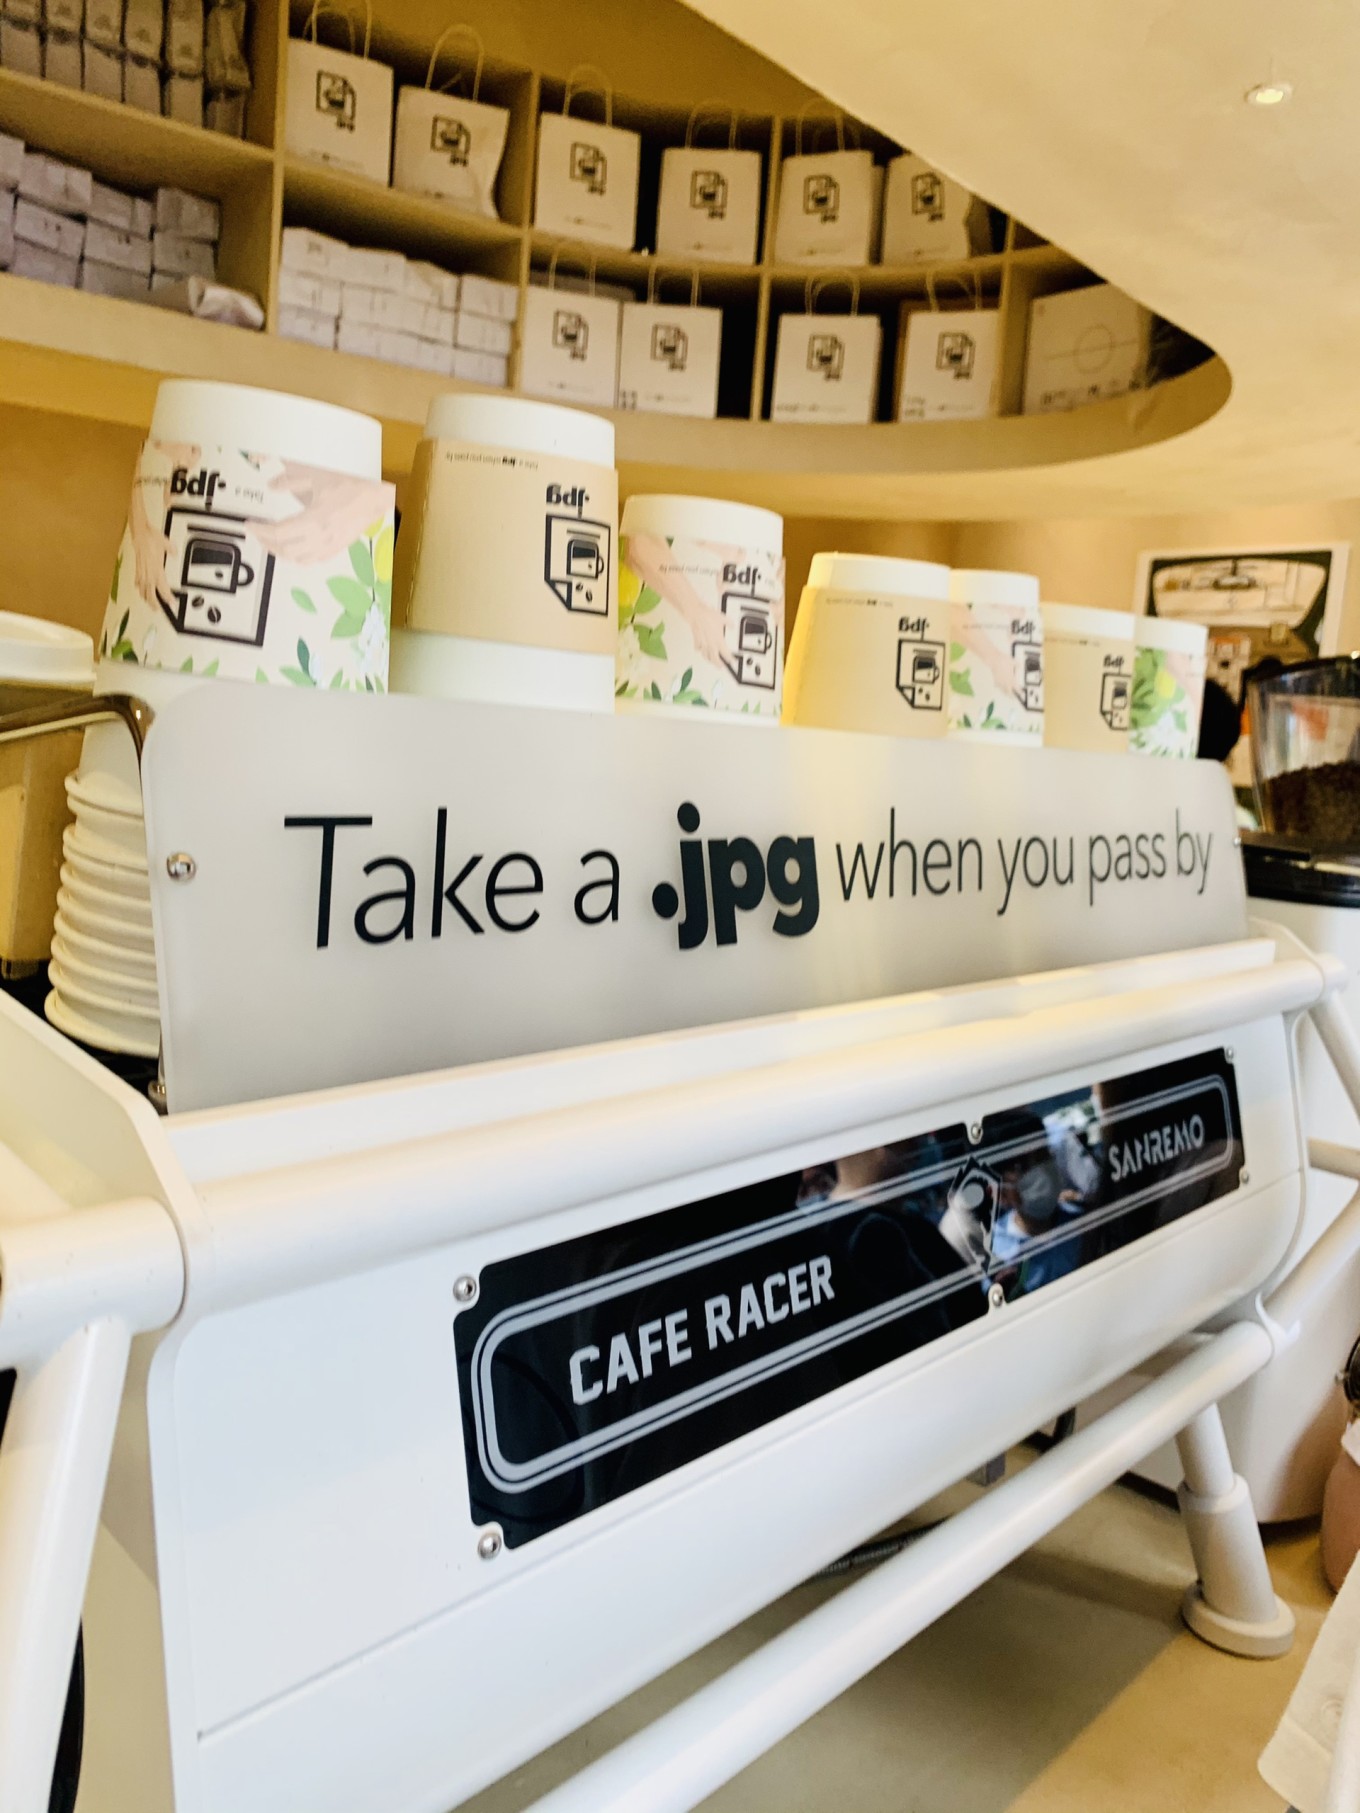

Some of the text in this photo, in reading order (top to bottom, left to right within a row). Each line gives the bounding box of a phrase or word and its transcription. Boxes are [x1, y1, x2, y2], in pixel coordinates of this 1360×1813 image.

[170, 467, 227, 506] .jpg
[546, 483, 590, 510] .jpg
[284, 801, 1213, 950] Take a .jpg when you pass by
[1108, 1113, 1205, 1182] SANREMO
[569, 1254, 835, 1405] CAFE RACER
